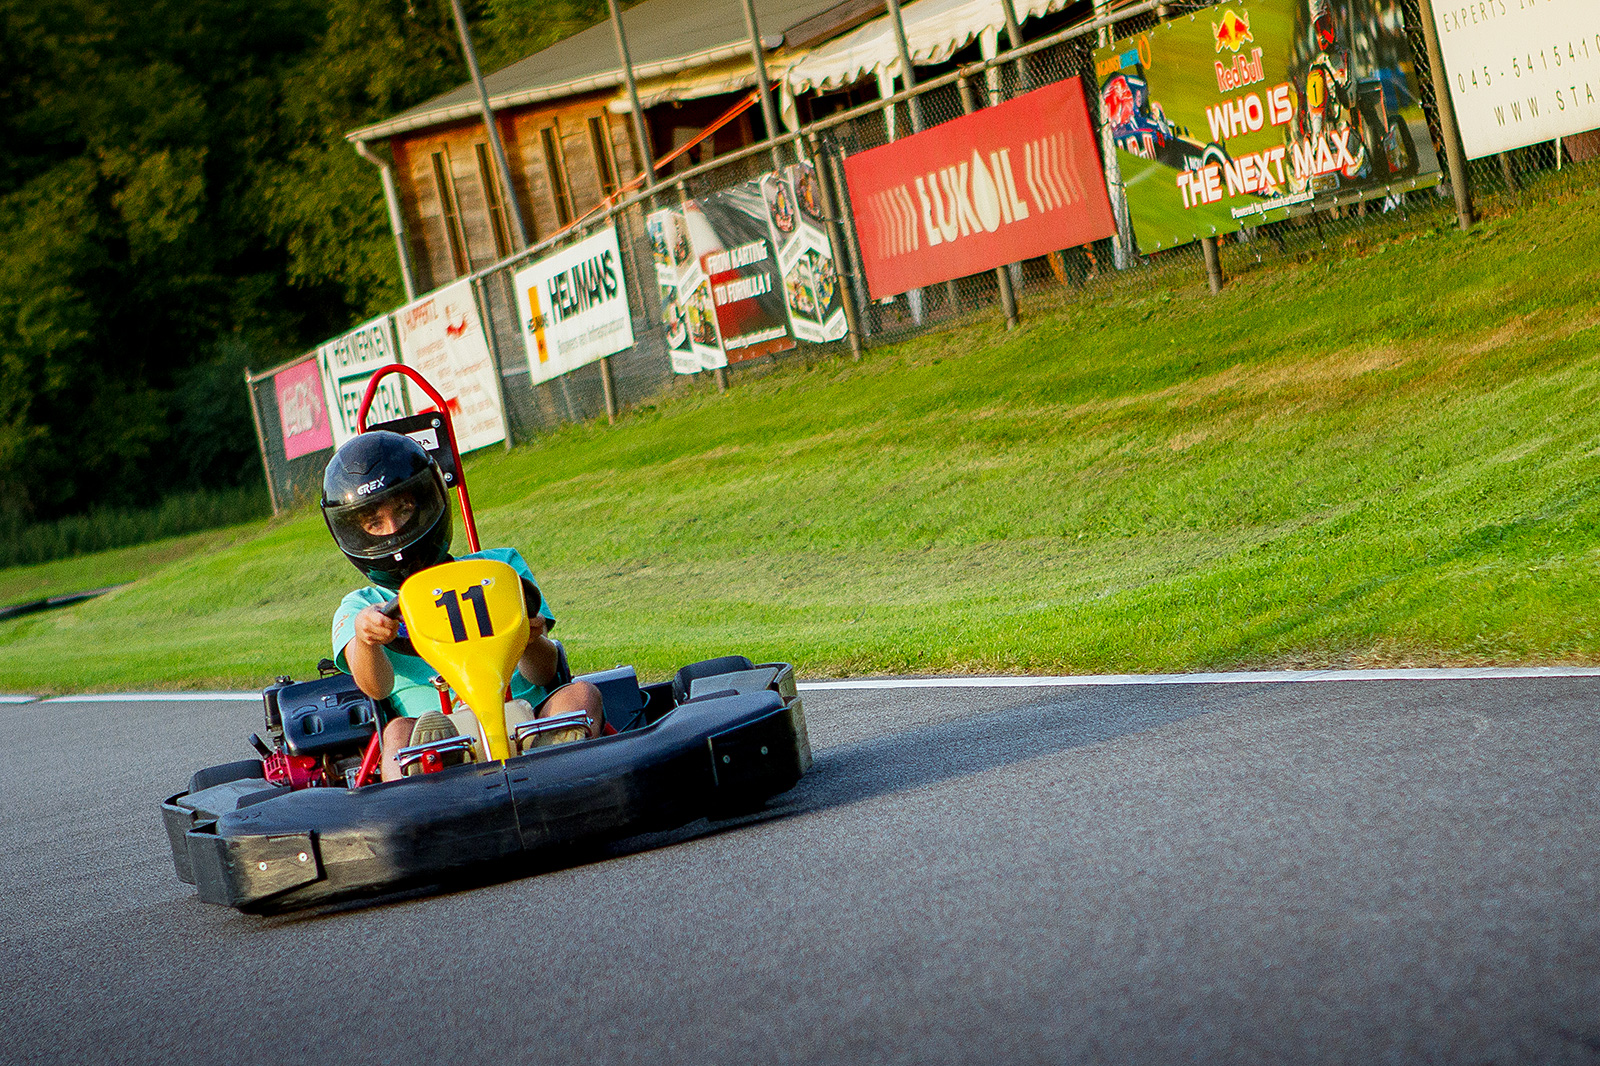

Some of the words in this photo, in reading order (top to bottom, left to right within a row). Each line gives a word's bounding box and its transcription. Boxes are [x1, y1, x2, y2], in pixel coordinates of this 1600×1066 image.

[1443, 0, 1506, 33] EXPERTS
[1214, 58, 1242, 93] Red
[1239, 47, 1265, 84] Bull
[1206, 91, 1264, 143] WHO
[1267, 82, 1294, 127] IS
[1494, 80, 1600, 126] WWW.STA
[1177, 163, 1223, 209] THE
[1224, 145, 1286, 198] NEXT
[1293, 128, 1355, 184] MAX
[915, 148, 1030, 247] LUKOIL
[547, 249, 618, 325] HEIJMANS
[714, 284, 727, 307] TO
[357, 475, 386, 495] GREX
[435, 585, 494, 643] 11
